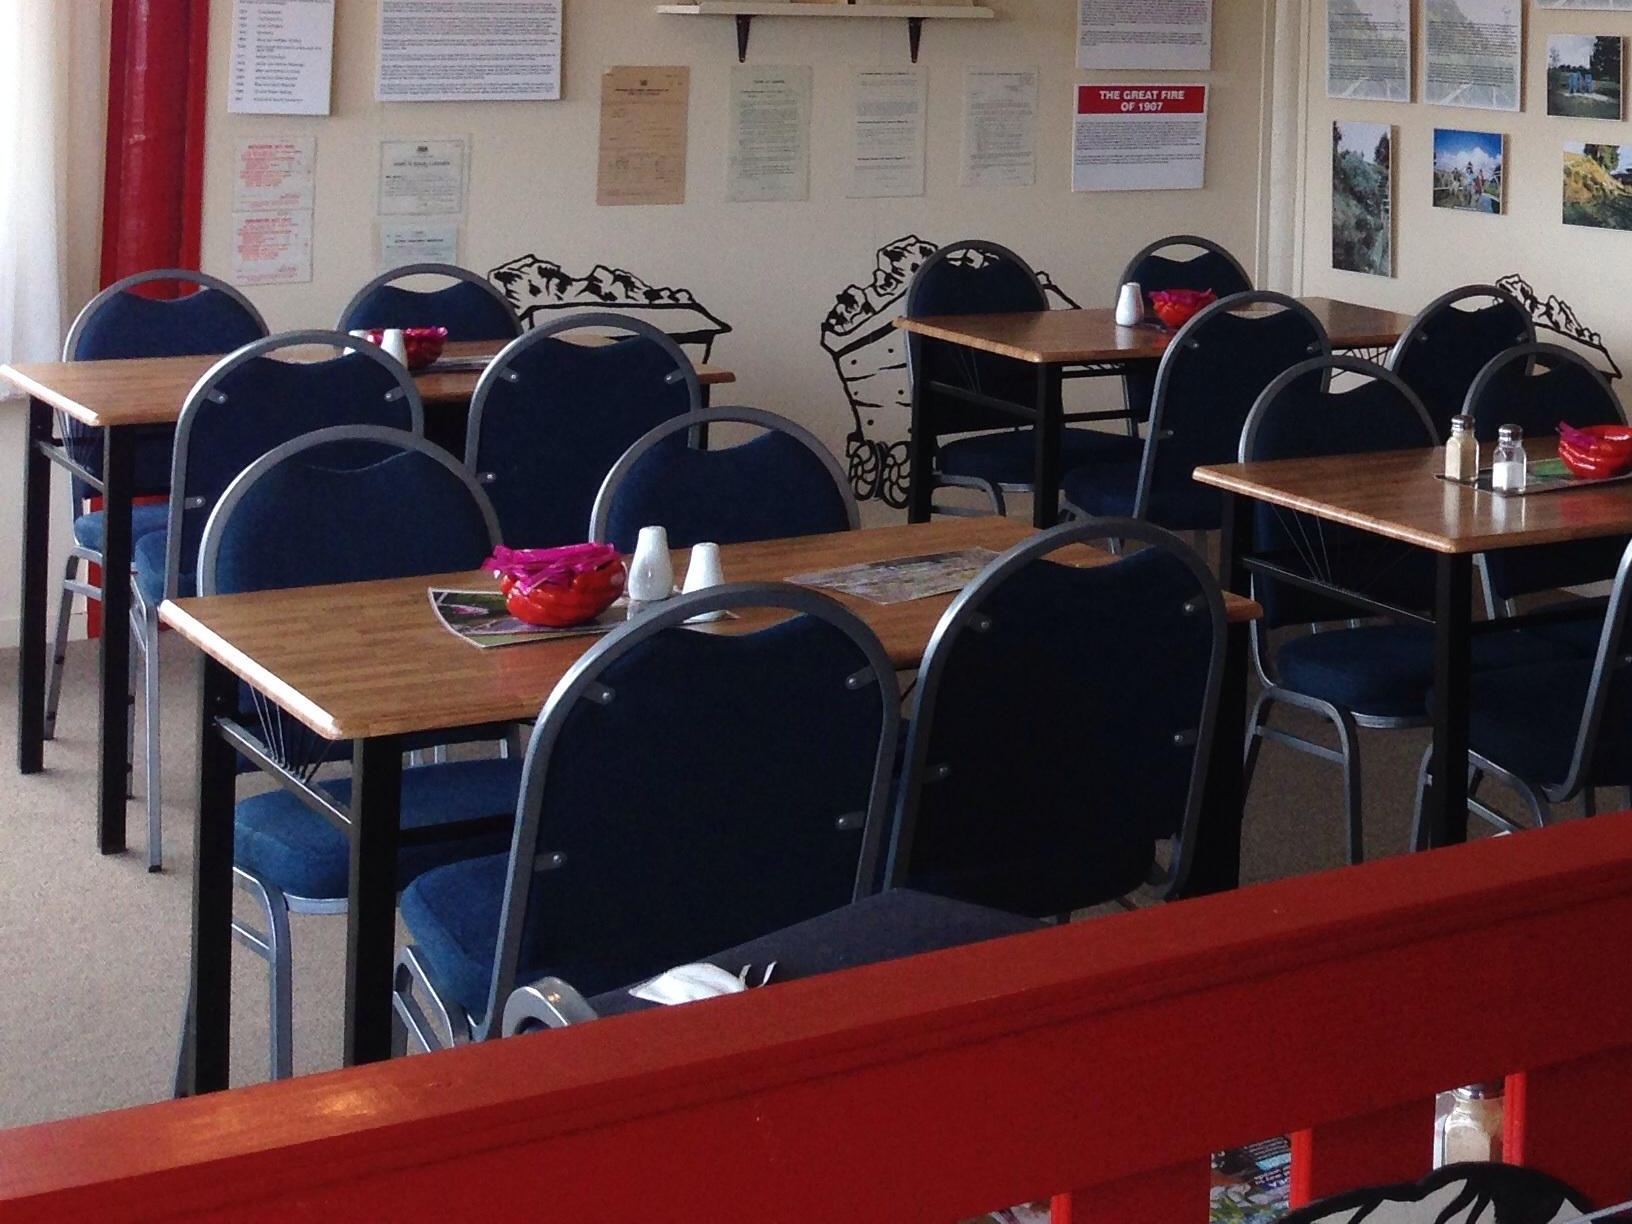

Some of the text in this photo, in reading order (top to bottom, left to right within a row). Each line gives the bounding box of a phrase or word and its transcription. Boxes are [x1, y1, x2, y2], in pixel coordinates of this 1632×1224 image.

[1099, 90, 1185, 100] THE GREAT FIRE
[1120, 101, 1164, 112] OF 1907
